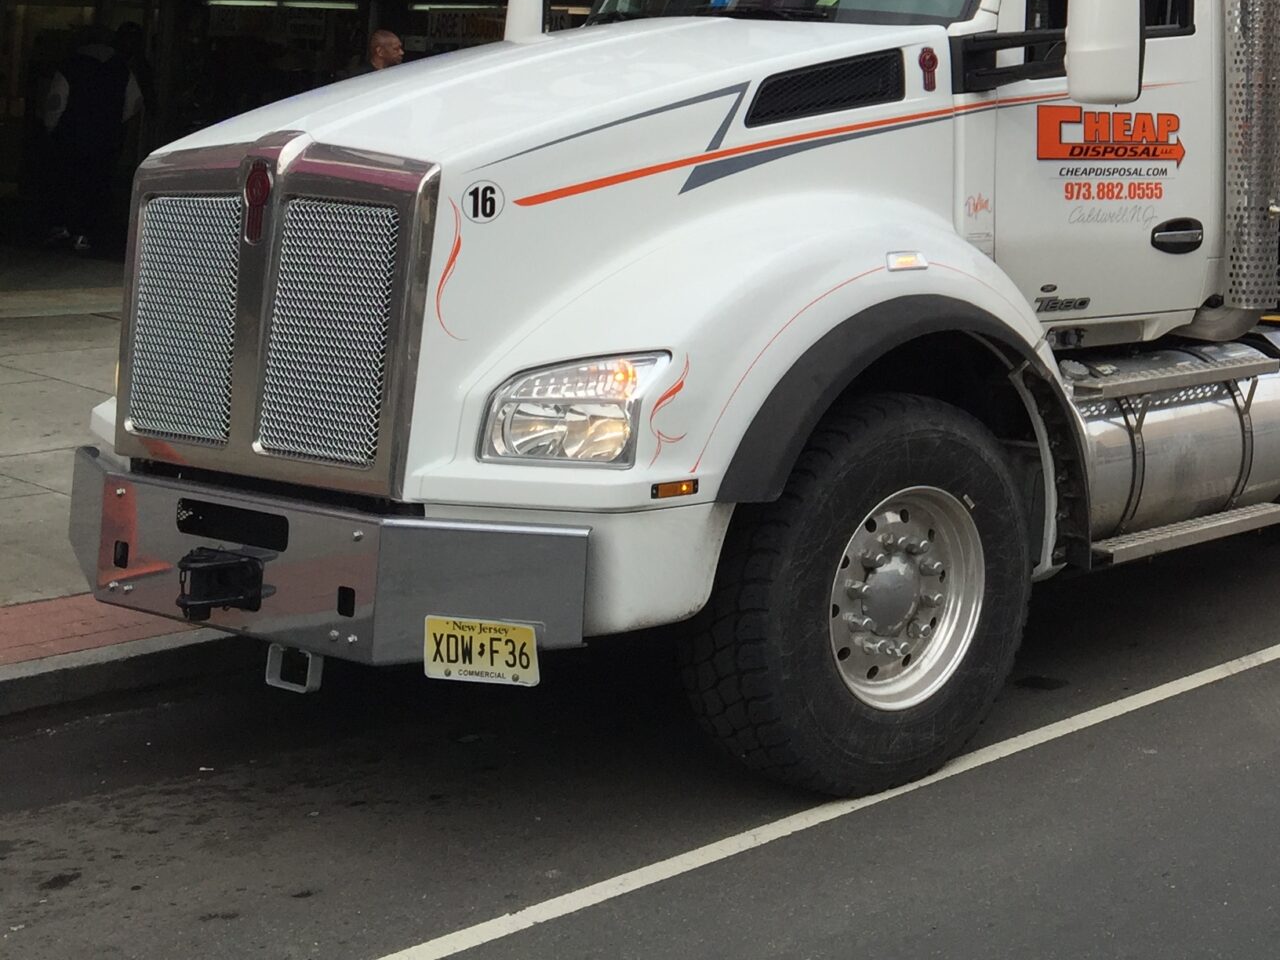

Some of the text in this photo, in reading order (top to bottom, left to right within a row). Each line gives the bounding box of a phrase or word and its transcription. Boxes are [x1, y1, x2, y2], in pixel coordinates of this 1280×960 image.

[1037, 105, 1180, 160] CHEAP
[1069, 145, 1161, 158] DISPOSAL
[1059, 167, 1168, 178] CHEAPDISPOSAL.COM
[1064, 182, 1163, 201] 973.882.0555
[468, 185, 496, 218] 16
[1034, 296, 1091, 313] T880
[452, 621, 510, 637] New Jersey
[432, 632, 531, 670] XDW F36
[457, 669, 507, 680] COMMERCIAL
